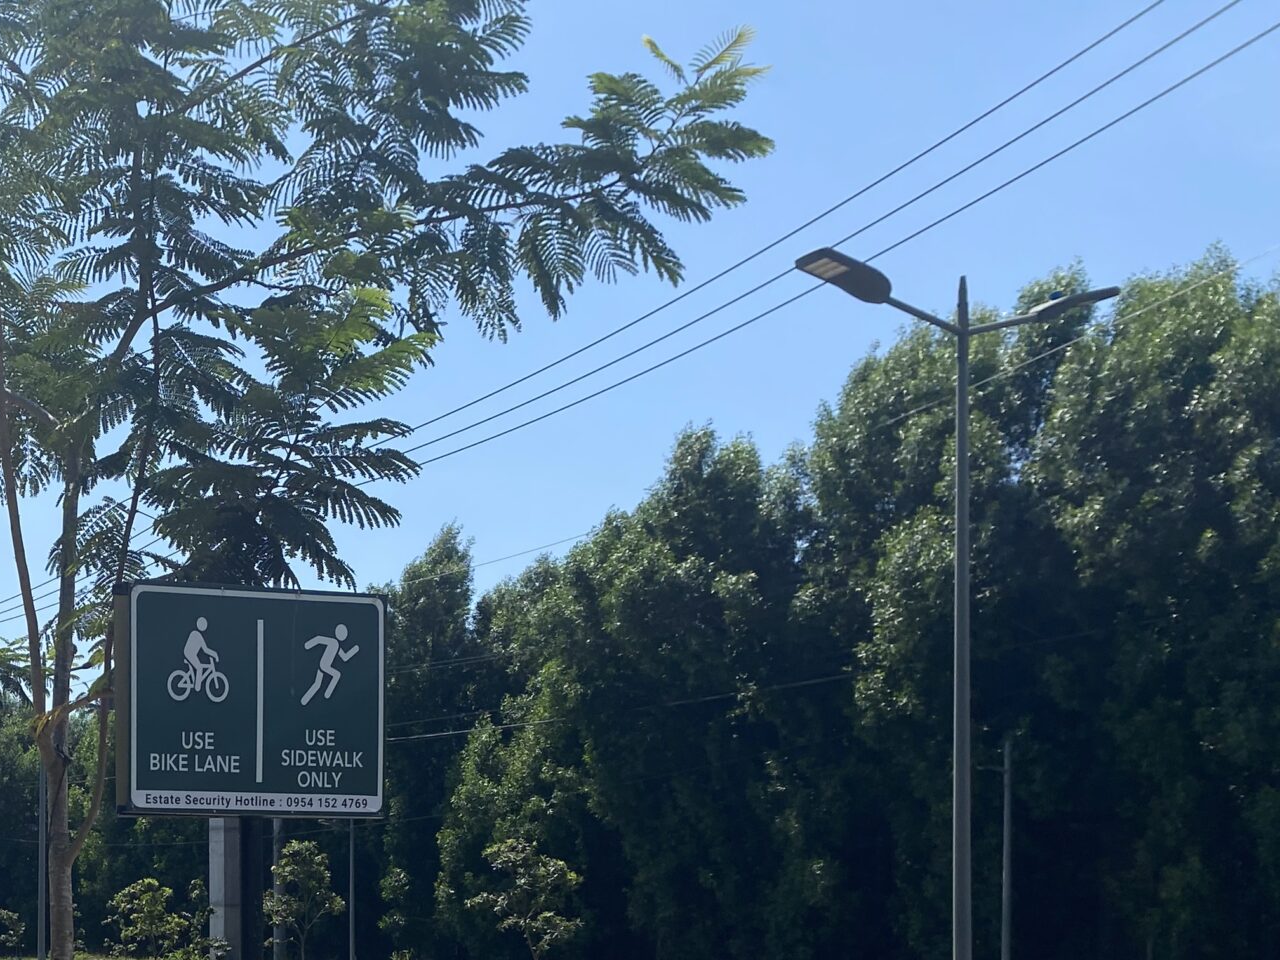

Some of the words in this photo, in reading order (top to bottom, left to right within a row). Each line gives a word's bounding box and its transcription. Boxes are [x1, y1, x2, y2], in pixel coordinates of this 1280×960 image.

[181, 731, 215, 750] USE
[305, 729, 335, 747] USE
[149, 753, 189, 772] BIKE
[194, 754, 240, 773] LANE
[280, 749, 363, 768] SIDEWALK
[297, 771, 342, 789] ONLY
[145, 793, 181, 806] Estate
[184, 794, 231, 810] Security
[235, 795, 276, 808] Hotline
[286, 796, 314, 808] 0954
[317, 797, 339, 809] 152
[341, 798, 368, 809] 4769
